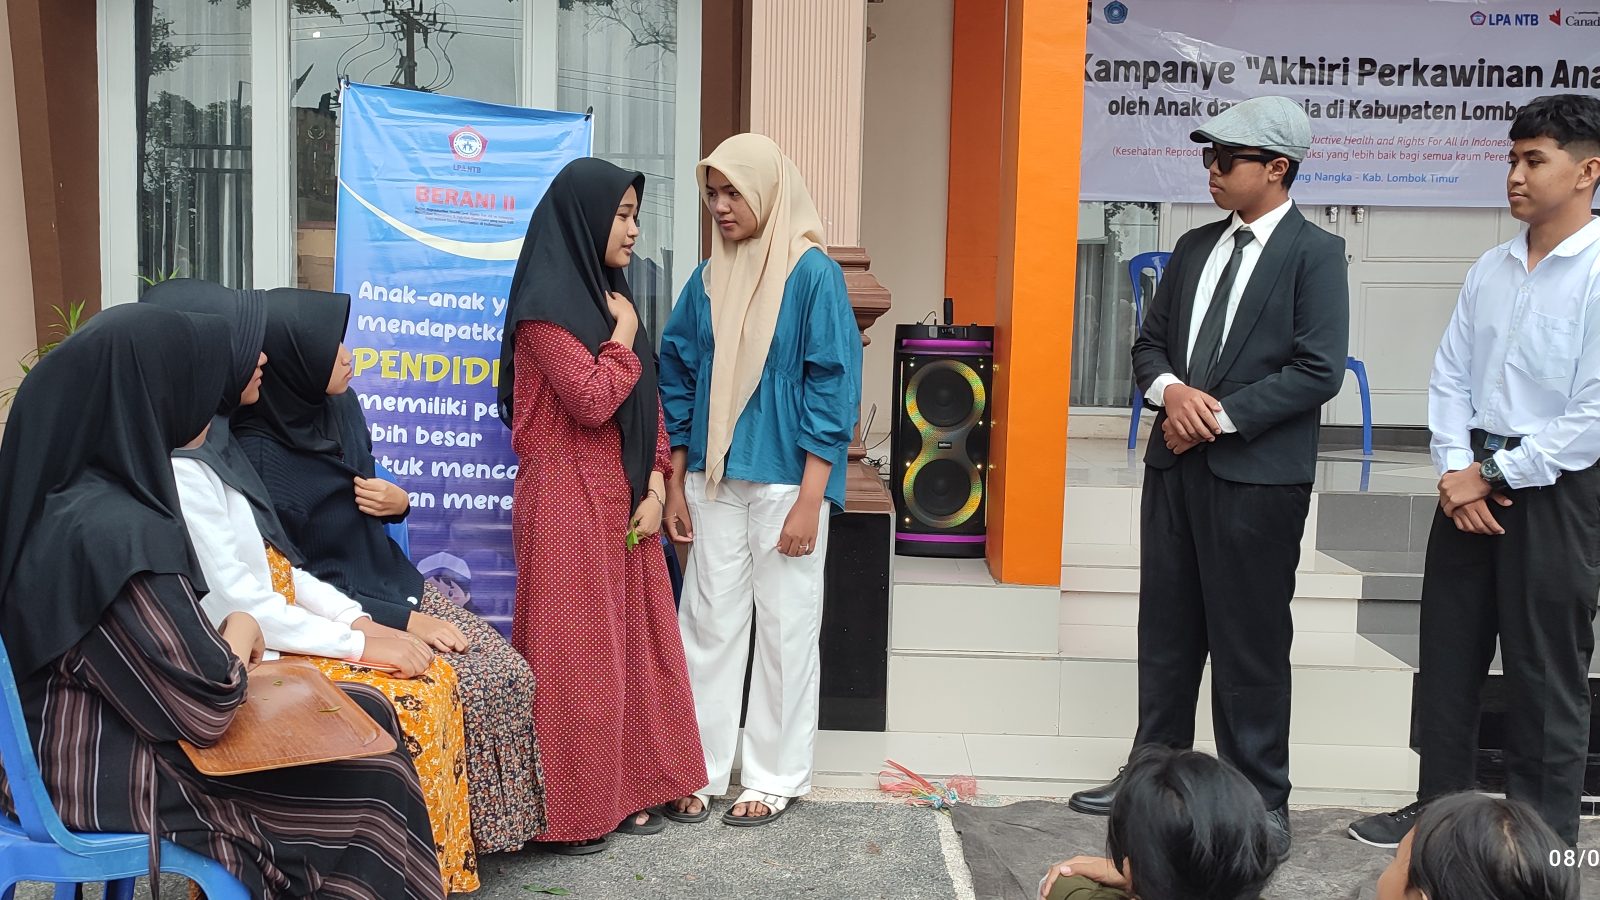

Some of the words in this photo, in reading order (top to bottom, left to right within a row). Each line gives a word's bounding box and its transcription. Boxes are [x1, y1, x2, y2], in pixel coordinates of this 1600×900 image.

[1488, 14, 1511, 26] LPA
[1514, 14, 1539, 26] NTB
[1246, 56, 1350, 86] "Akhiri
[1358, 57, 1543, 88] Perkawinan
[1108, 96, 1150, 116] oleh
[1154, 97, 1202, 117] Anak
[1207, 98, 1239, 118] da
[1326, 98, 1344, 118] di
[1349, 99, 1456, 124] Kabupaten
[1343, 135, 1374, 145] Health
[1376, 136, 1394, 146] and
[1398, 136, 1425, 148] Rights
[1428, 137, 1442, 146] For
[1444, 136, 1458, 146] All
[1460, 138, 1468, 146] in
[1112, 146, 1163, 158] (Kesehatan
[1326, 151, 1349, 162] yang
[1352, 151, 1374, 160] lebih
[1378, 151, 1396, 160] baik
[1399, 151, 1420, 162] bagi
[1456, 151, 1481, 161] kaum
[1314, 172, 1352, 184] Nangka
[1362, 172, 1384, 182] Kab.
[1387, 173, 1427, 182] Lombok
[1430, 174, 1460, 184] Timur
[415, 185, 496, 210] BERANI
[358, 281, 485, 311] Anak-anak
[492, 296, 508, 318] y
[358, 394, 467, 416] memiliki
[368, 423, 408, 444] bih
[416, 426, 482, 448] besar
[376, 456, 424, 476] tuk
